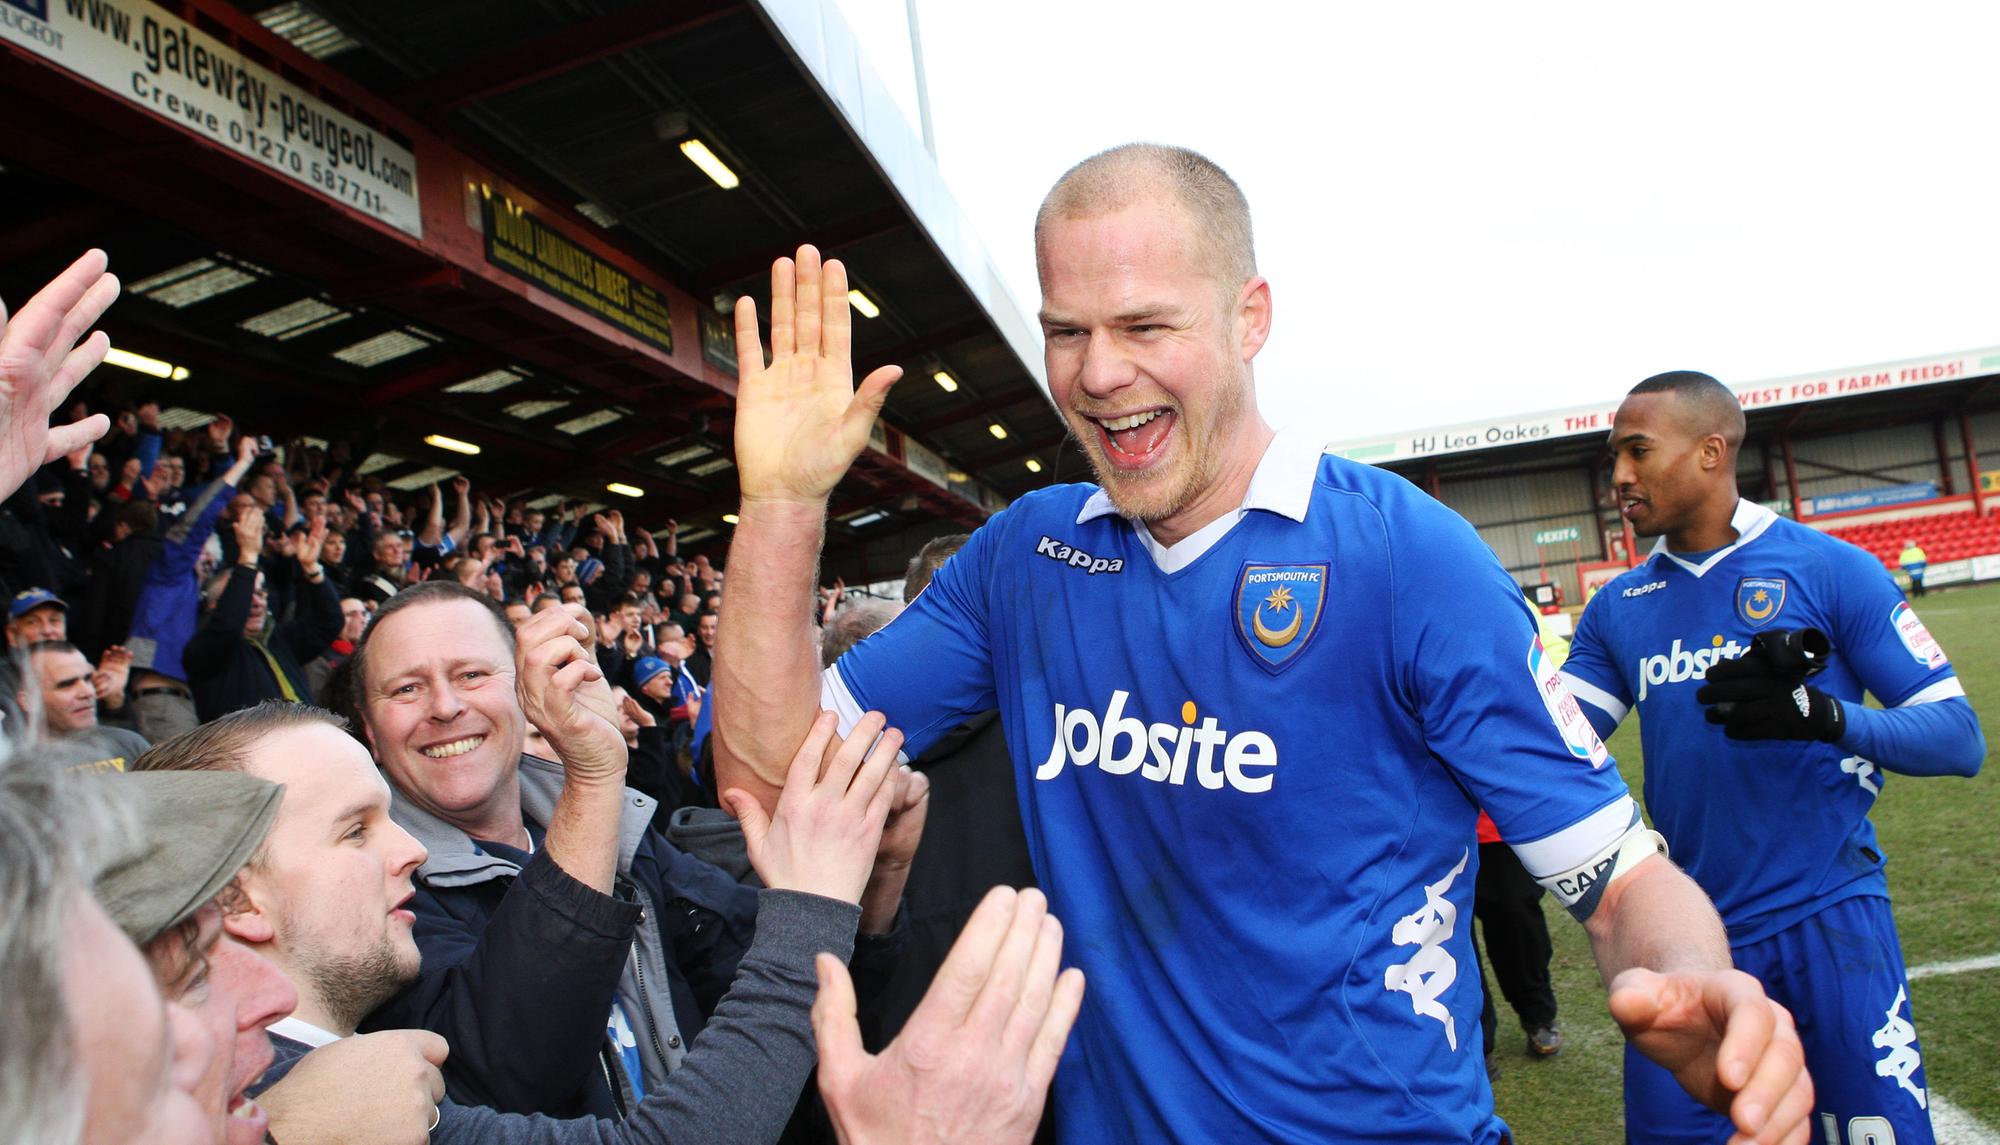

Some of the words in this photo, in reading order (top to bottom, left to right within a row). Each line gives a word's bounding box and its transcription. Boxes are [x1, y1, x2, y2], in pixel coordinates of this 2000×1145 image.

[132, 71, 219, 132] Crewe
[229, 123, 302, 173] 01270
[312, 162, 382, 212] 587711
[1791, 381, 1828, 399] FOR
[1838, 372, 1891, 392] FARM
[1900, 361, 1964, 383] FEEDS!
[1412, 437, 1436, 453] HJ
[1444, 434, 1477, 449] Lea
[1486, 424, 1550, 442] Oakes
[1564, 414, 1599, 431] THE
[1036, 535, 1124, 574] Kappa
[1248, 571, 1308, 584] PORTSMOUTH
[1308, 572, 1321, 582] FC
[1622, 580, 1667, 598] Kappa
